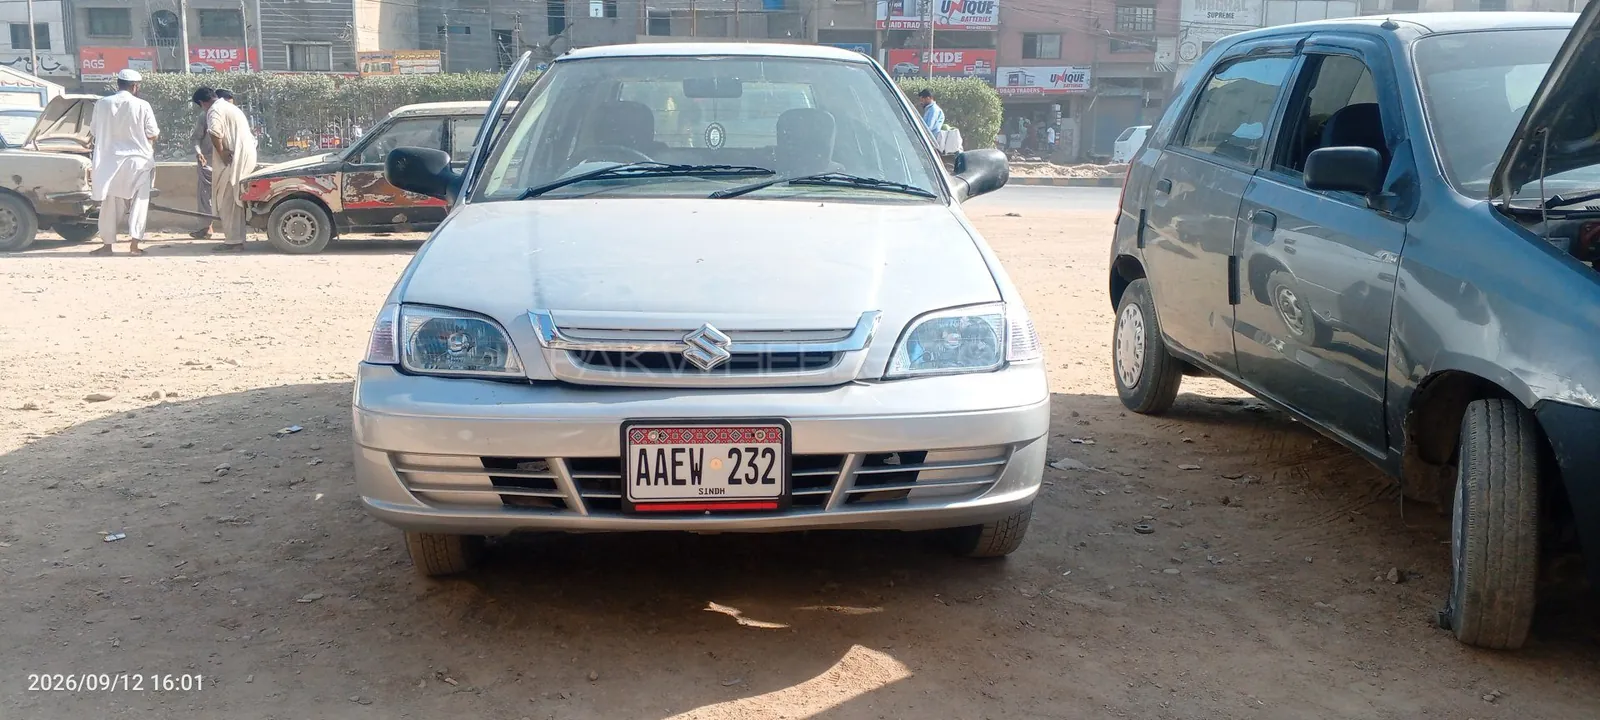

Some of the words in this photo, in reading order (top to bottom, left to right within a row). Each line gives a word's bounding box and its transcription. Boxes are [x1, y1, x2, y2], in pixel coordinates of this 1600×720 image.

[1206, 11, 1235, 19] SUPREME
[198, 48, 238, 59] EXIDE
[83, 60, 105, 68] AGS
[1050, 71, 1085, 86] UNIQUE
[636, 448, 704, 486] AAEW
[728, 447, 776, 484] 232
